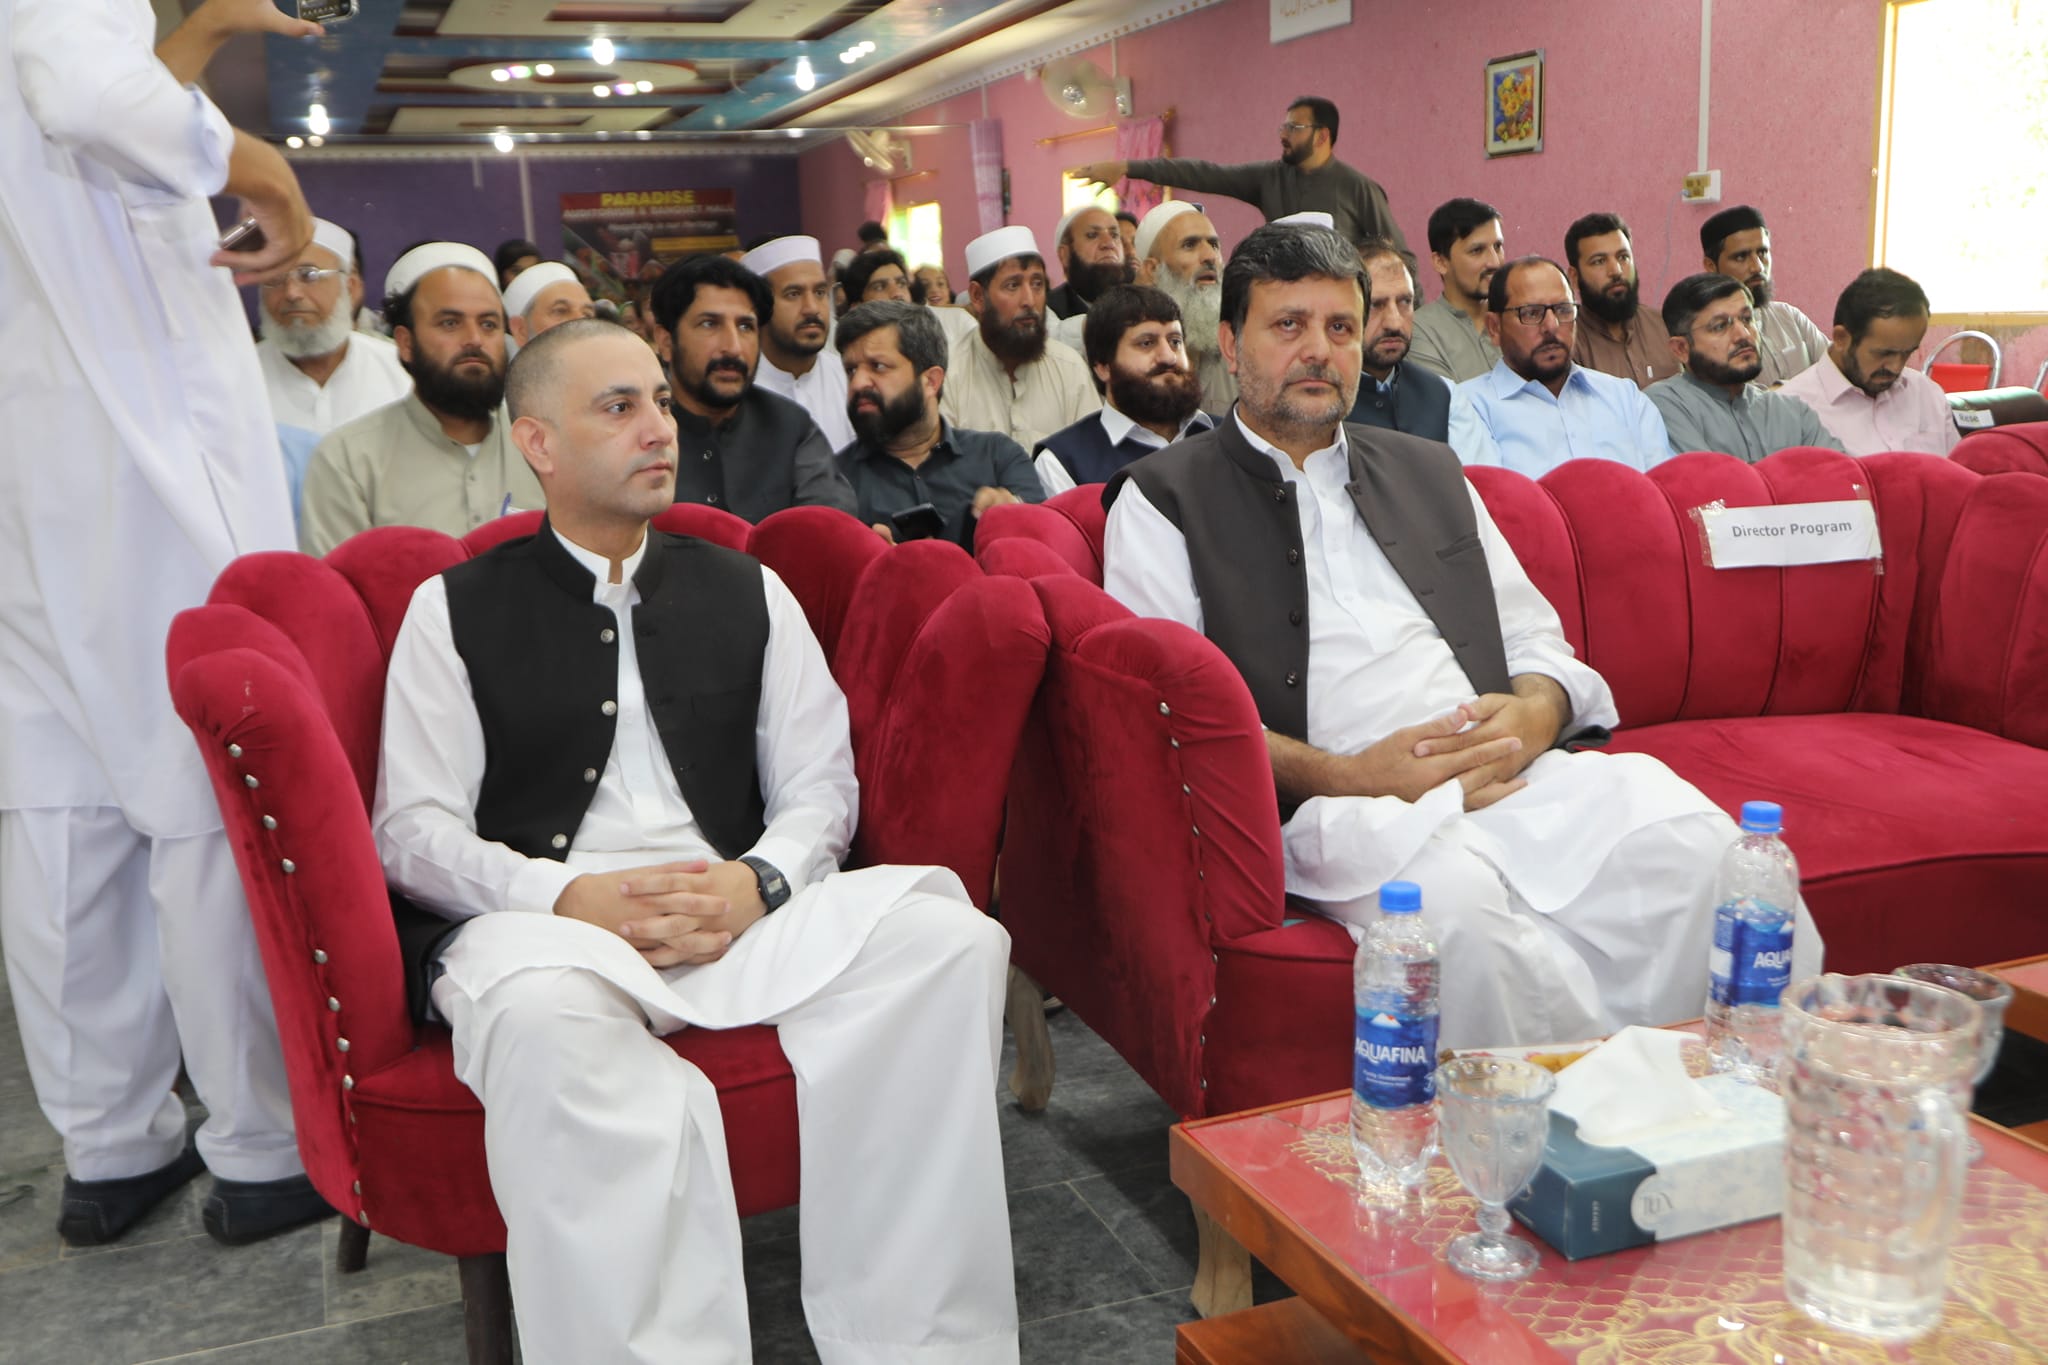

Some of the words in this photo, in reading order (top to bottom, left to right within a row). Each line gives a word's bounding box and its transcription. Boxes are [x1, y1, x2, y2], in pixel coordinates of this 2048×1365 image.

[601, 190, 695, 206] PARADISE
[1732, 525, 1785, 538] Director
[1790, 521, 1852, 537] Program
